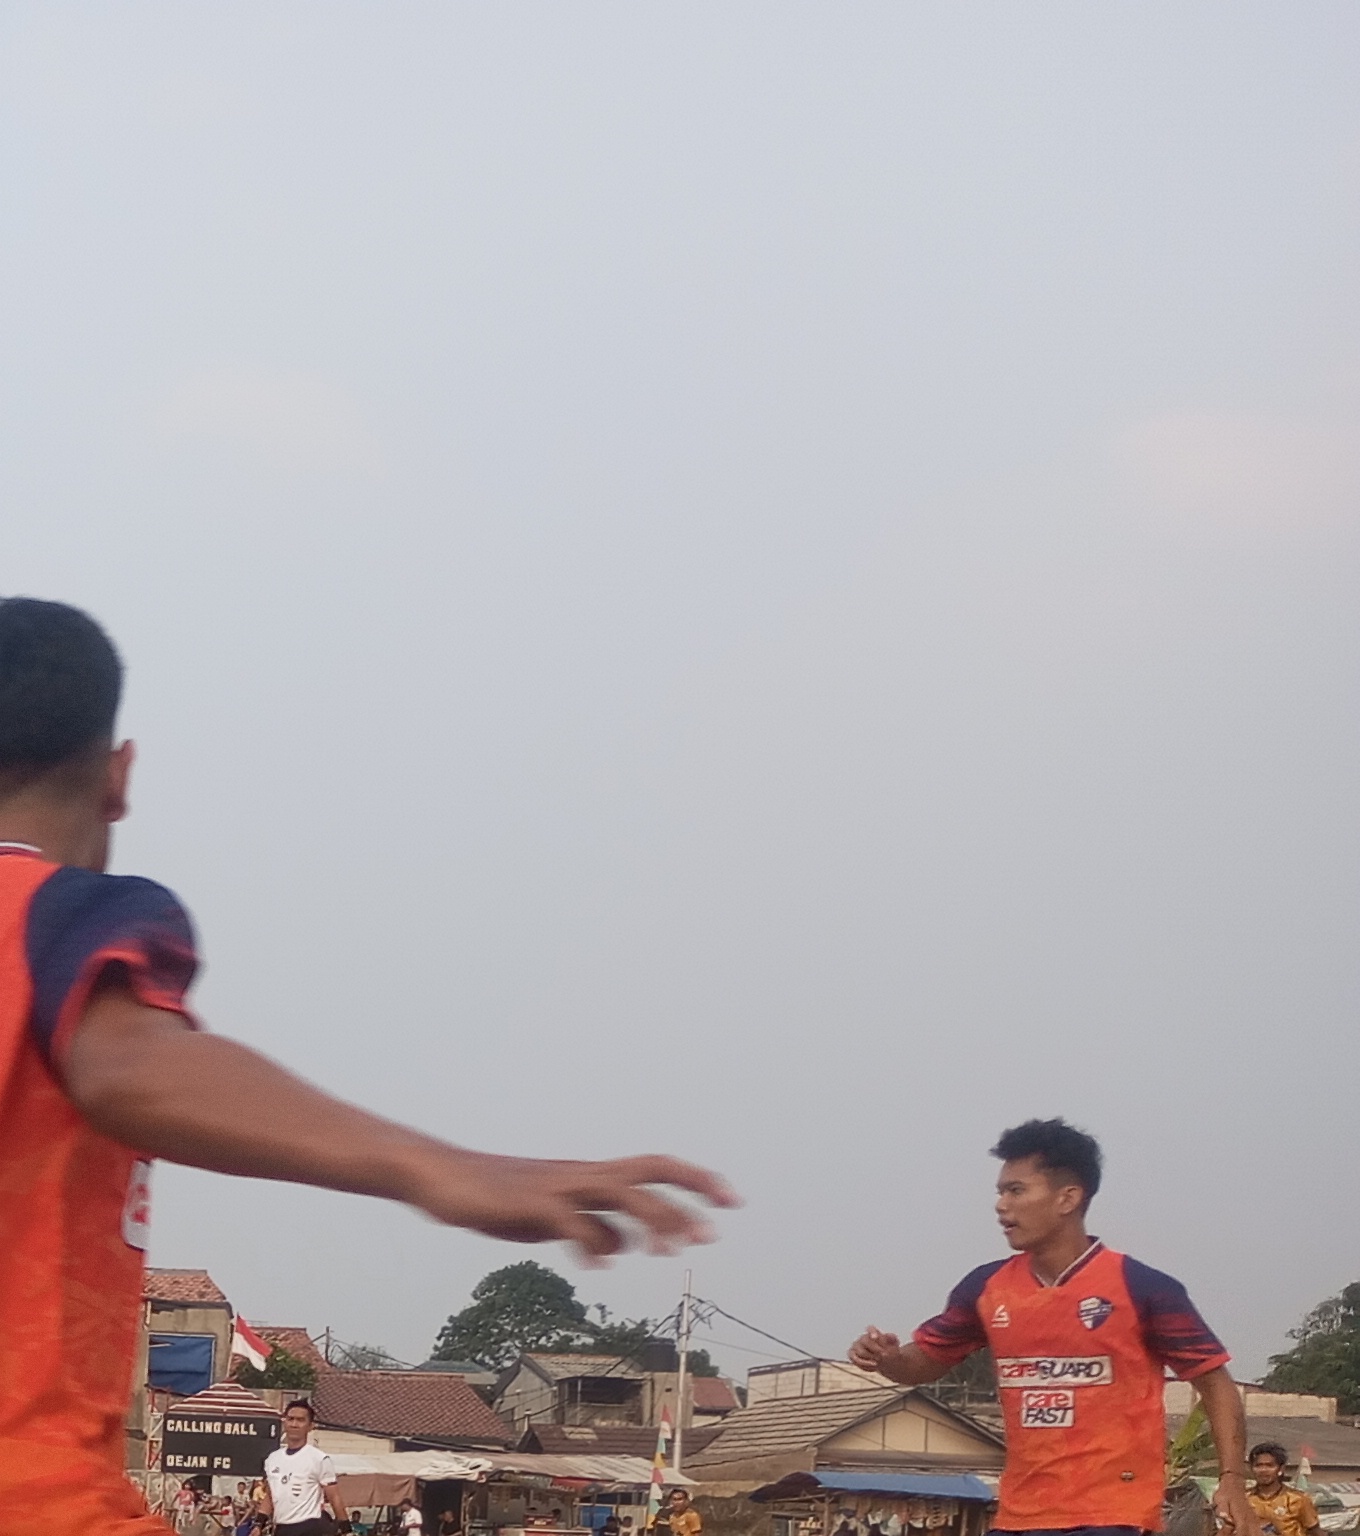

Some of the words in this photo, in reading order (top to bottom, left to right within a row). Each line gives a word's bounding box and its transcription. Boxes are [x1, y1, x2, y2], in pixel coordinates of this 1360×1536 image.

[1025, 1393, 1070, 1408] care
[1024, 1408, 1072, 1424] FAST
[166, 1419, 221, 1434] CALLING
[224, 1422, 257, 1436] BALL
[166, 1455, 208, 1468] DEJAN
[213, 1456, 231, 1469] FC
